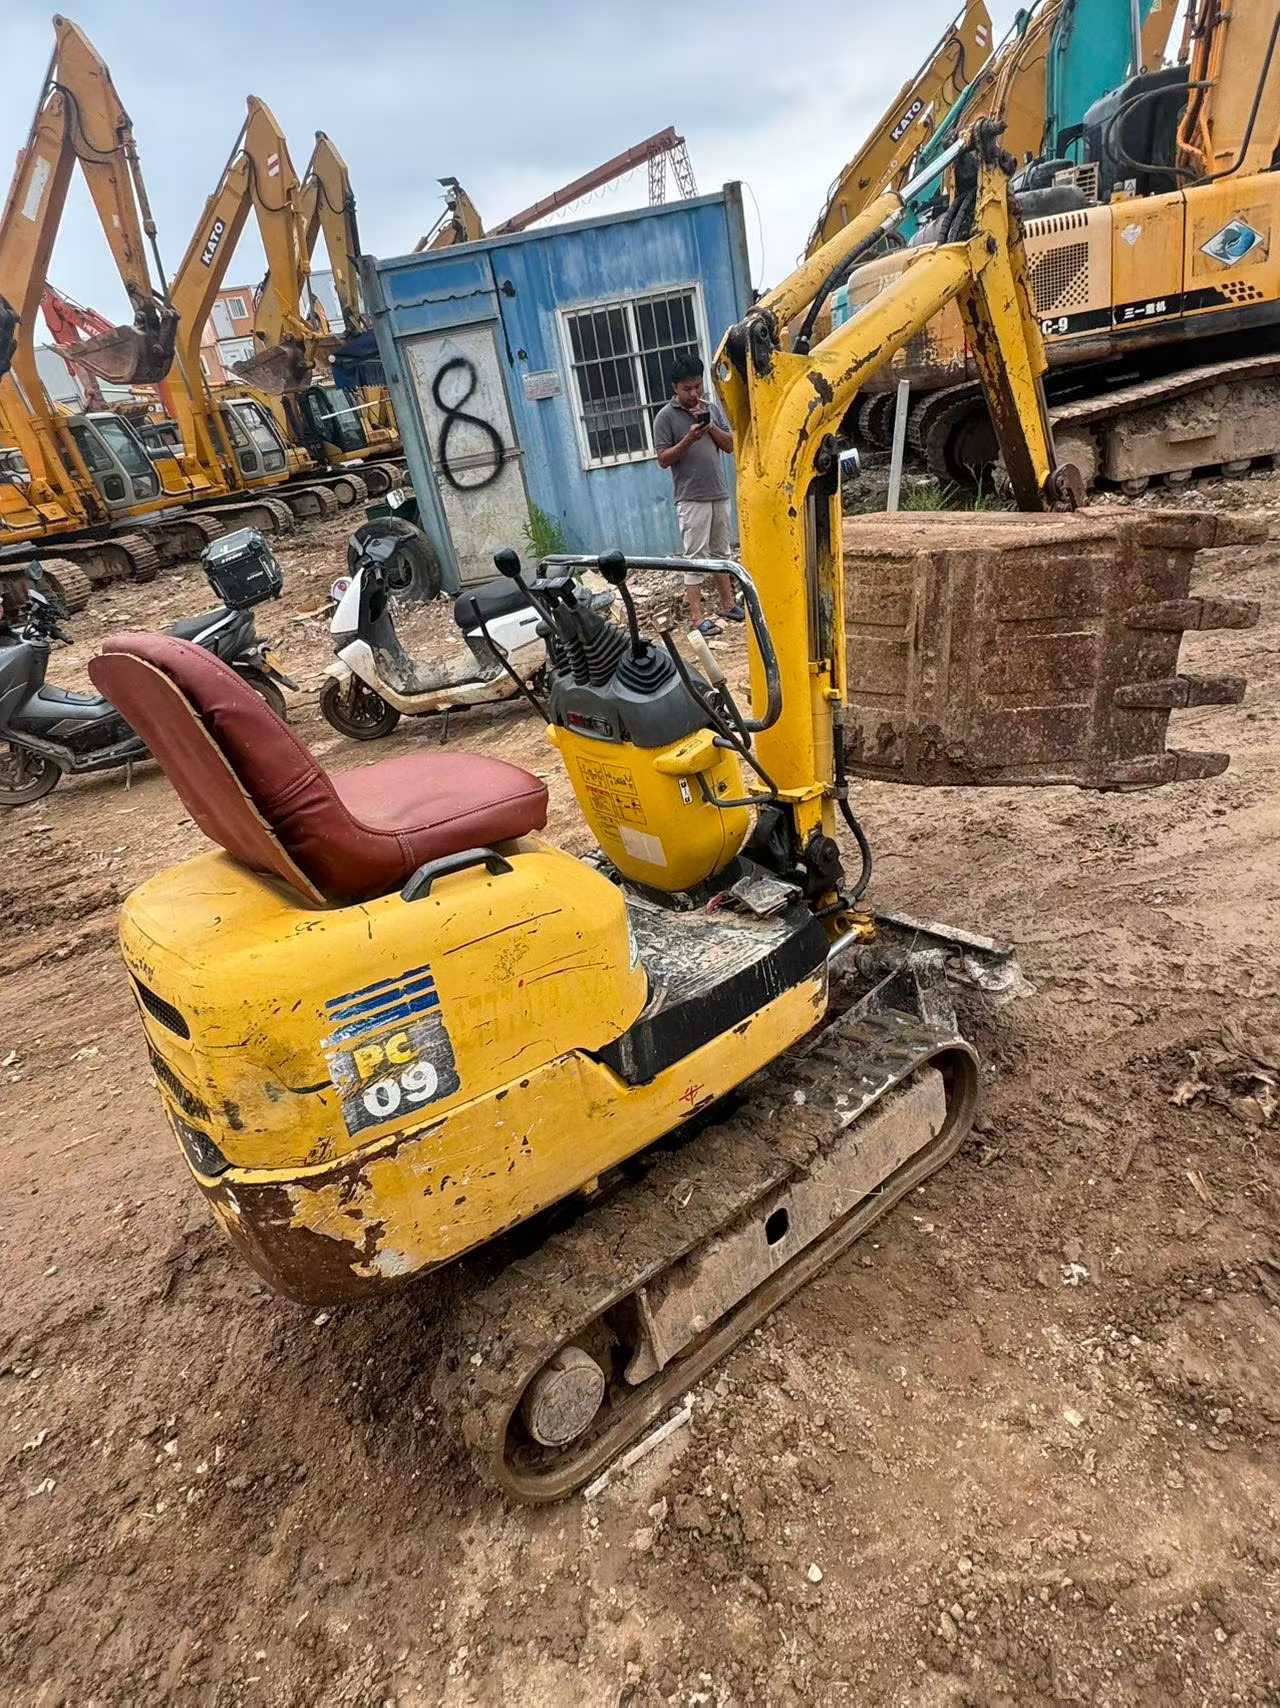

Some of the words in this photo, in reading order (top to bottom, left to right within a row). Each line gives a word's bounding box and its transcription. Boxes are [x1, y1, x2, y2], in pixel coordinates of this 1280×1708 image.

[892, 101, 921, 140] KATO
[202, 222, 224, 265] KATO
[1041, 317, 1068, 335] C-9
[432, 357, 505, 491] 8
[352, 1032, 413, 1079] PC
[363, 1061, 439, 1117] 09
